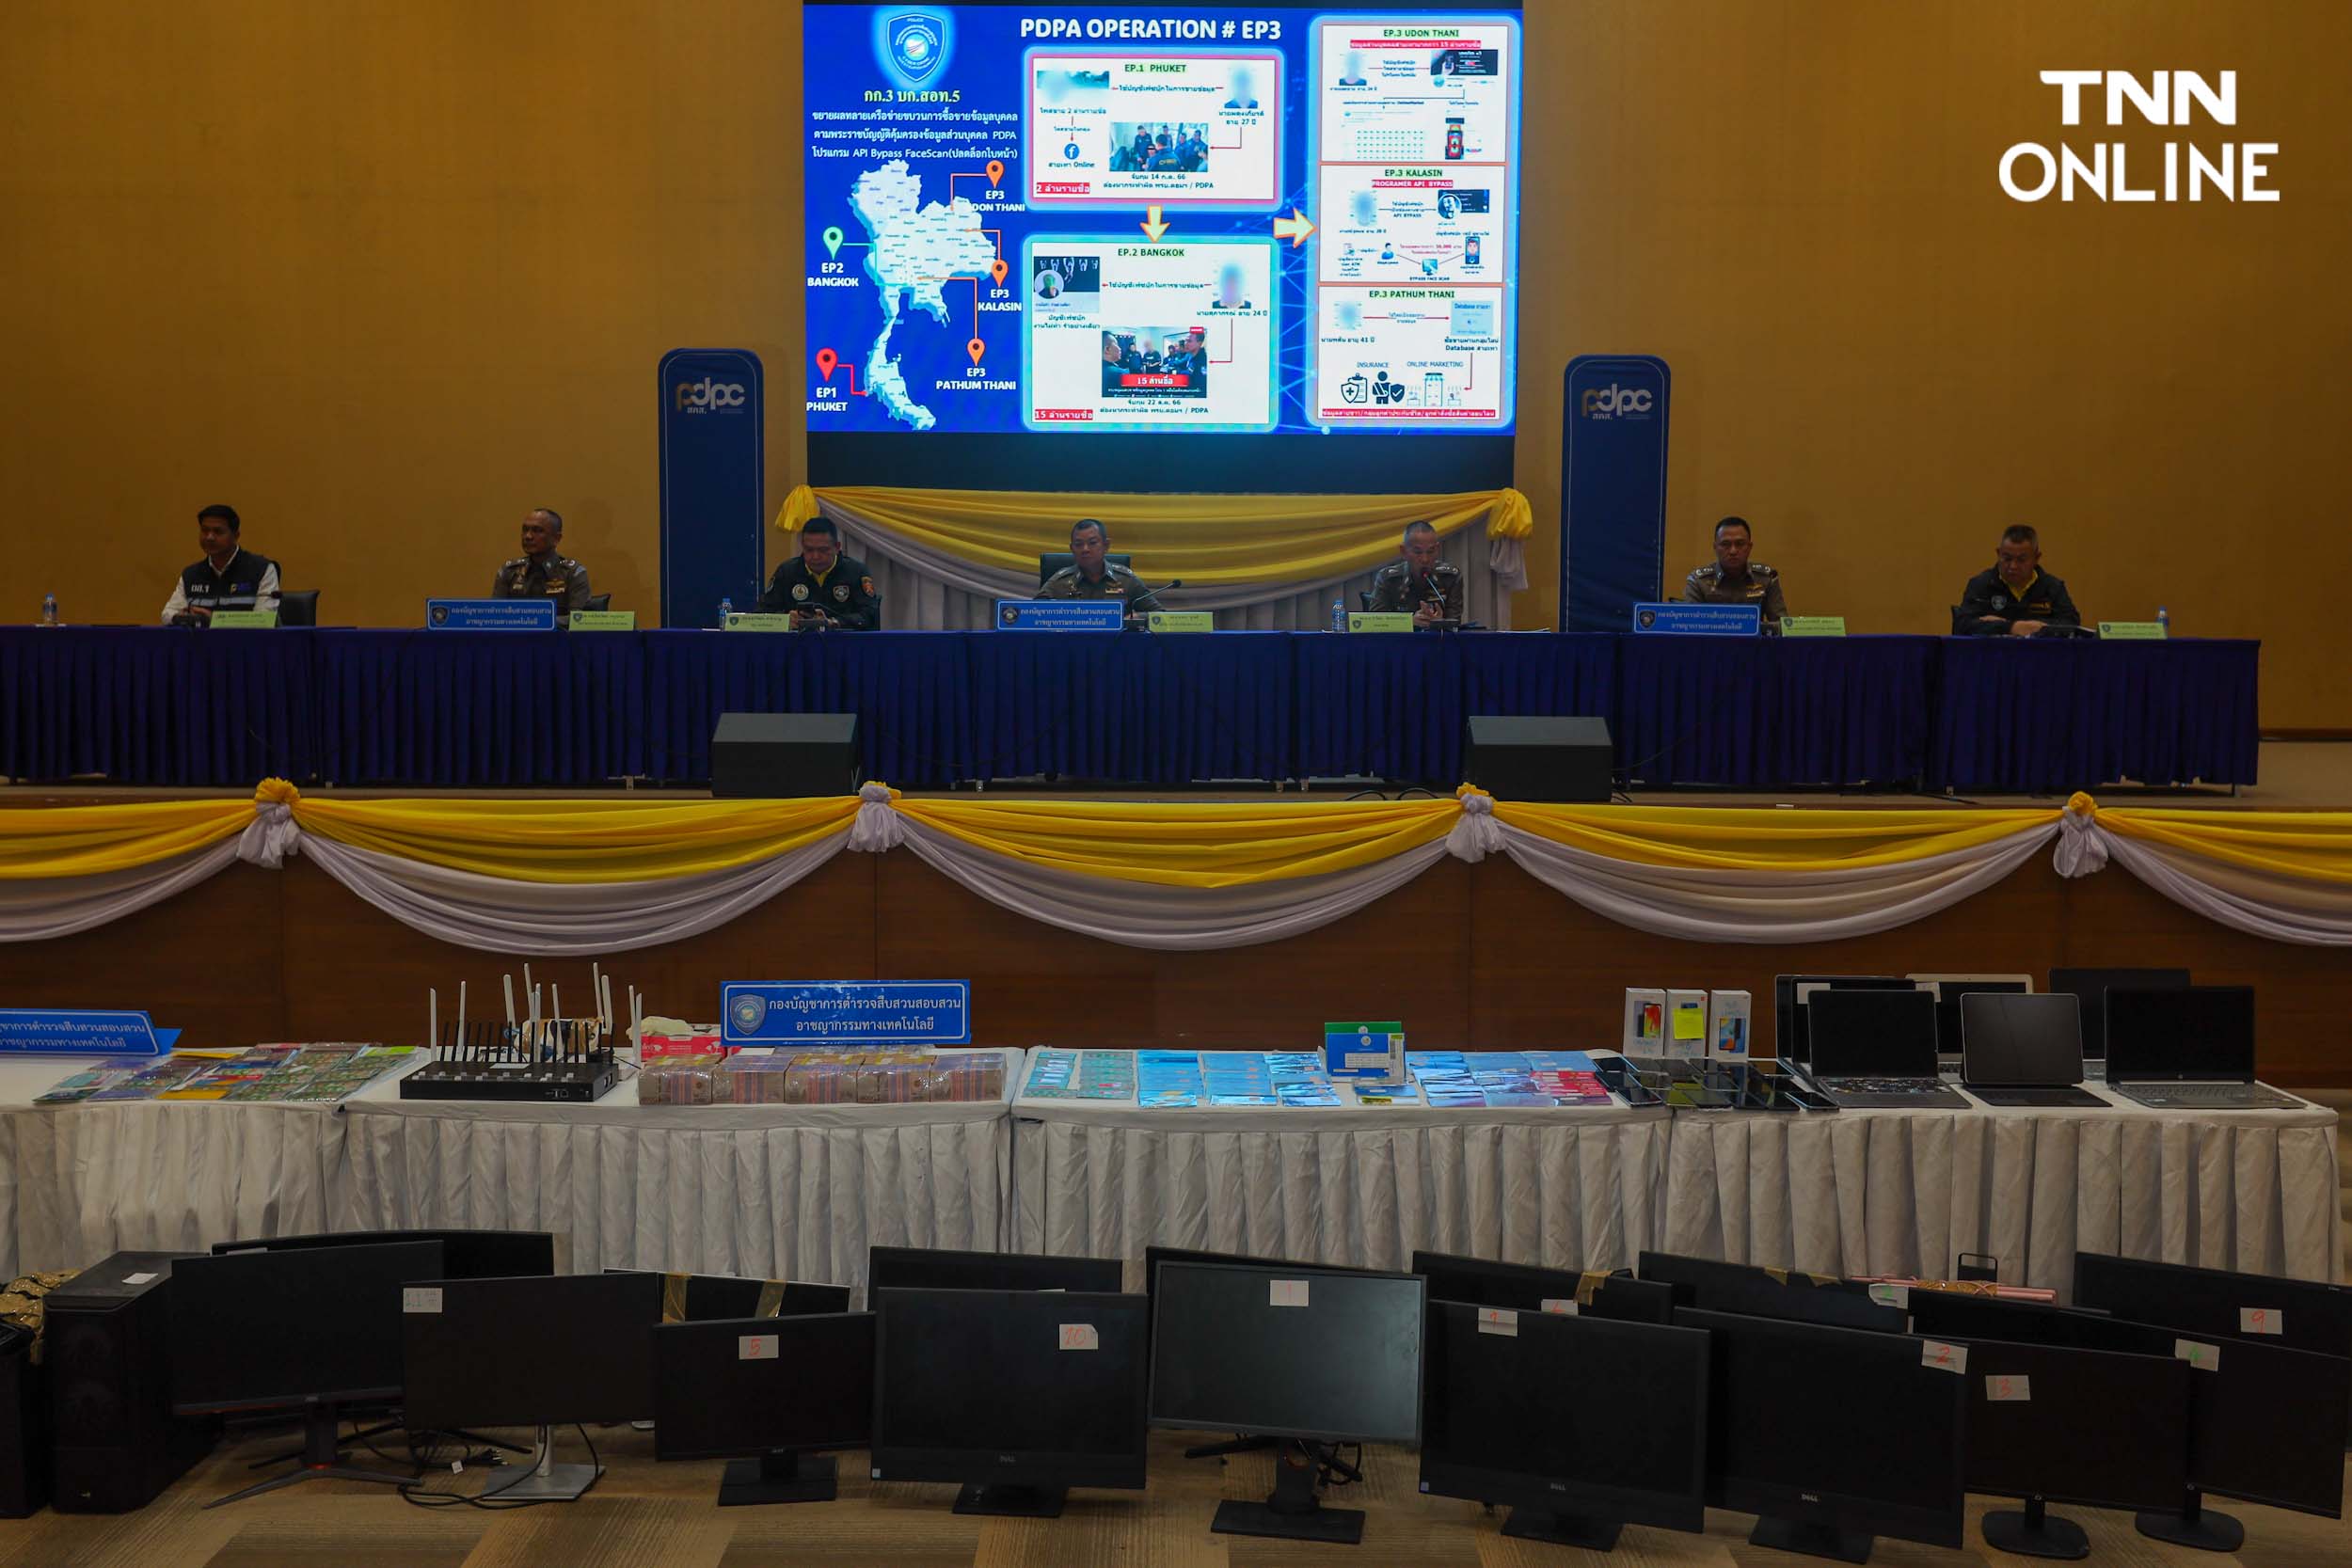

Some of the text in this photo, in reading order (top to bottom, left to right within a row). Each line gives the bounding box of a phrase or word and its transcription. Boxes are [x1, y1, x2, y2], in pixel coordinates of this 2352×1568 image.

[1020, 19, 1281, 40] PDPA OPERATION # EP3
[1124, 64, 1187, 72] EP.1 PHUKET
[864, 89, 893, 103] กก.3
[993, 132, 1017, 140] PDPA
[812, 146, 850, 157] โปรแกรม
[852, 149, 868, 157] API
[870, 149, 902, 159] Bypass
[986, 190, 1005, 199] EP3
[994, 203, 1025, 212] THANI
[821, 262, 844, 274] EP2
[807, 277, 859, 287] BANGKOK
[990, 289, 1009, 298] EP3
[977, 302, 1022, 311] KALASIN
[966, 368, 986, 377] EP3
[936, 381, 1016, 390] PATHUM THANI
[675, 377, 745, 411] pdpc
[816, 388, 836, 398] EP1
[1581, 384, 1652, 418] pdpc
[806, 403, 848, 412] PHUKET
[769, 993, 961, 1014] กองบัญชาการตำรวจสืบสวนสอบสวน
[0, 1020, 146, 1034] ชาการตำรวจสืบสวนสอบสวน
[796, 1018, 934, 1034] อาชญากรรมทางเทคโนโลยี
[2251, 1310, 2266, 1335] 9
[1064, 1327, 1087, 1346] 10
[749, 1338, 761, 1356] 5
[1935, 1346, 1950, 1364] 2
[1997, 1378, 2013, 1399] 3
[1801, 1493, 1819, 1503] DELL
